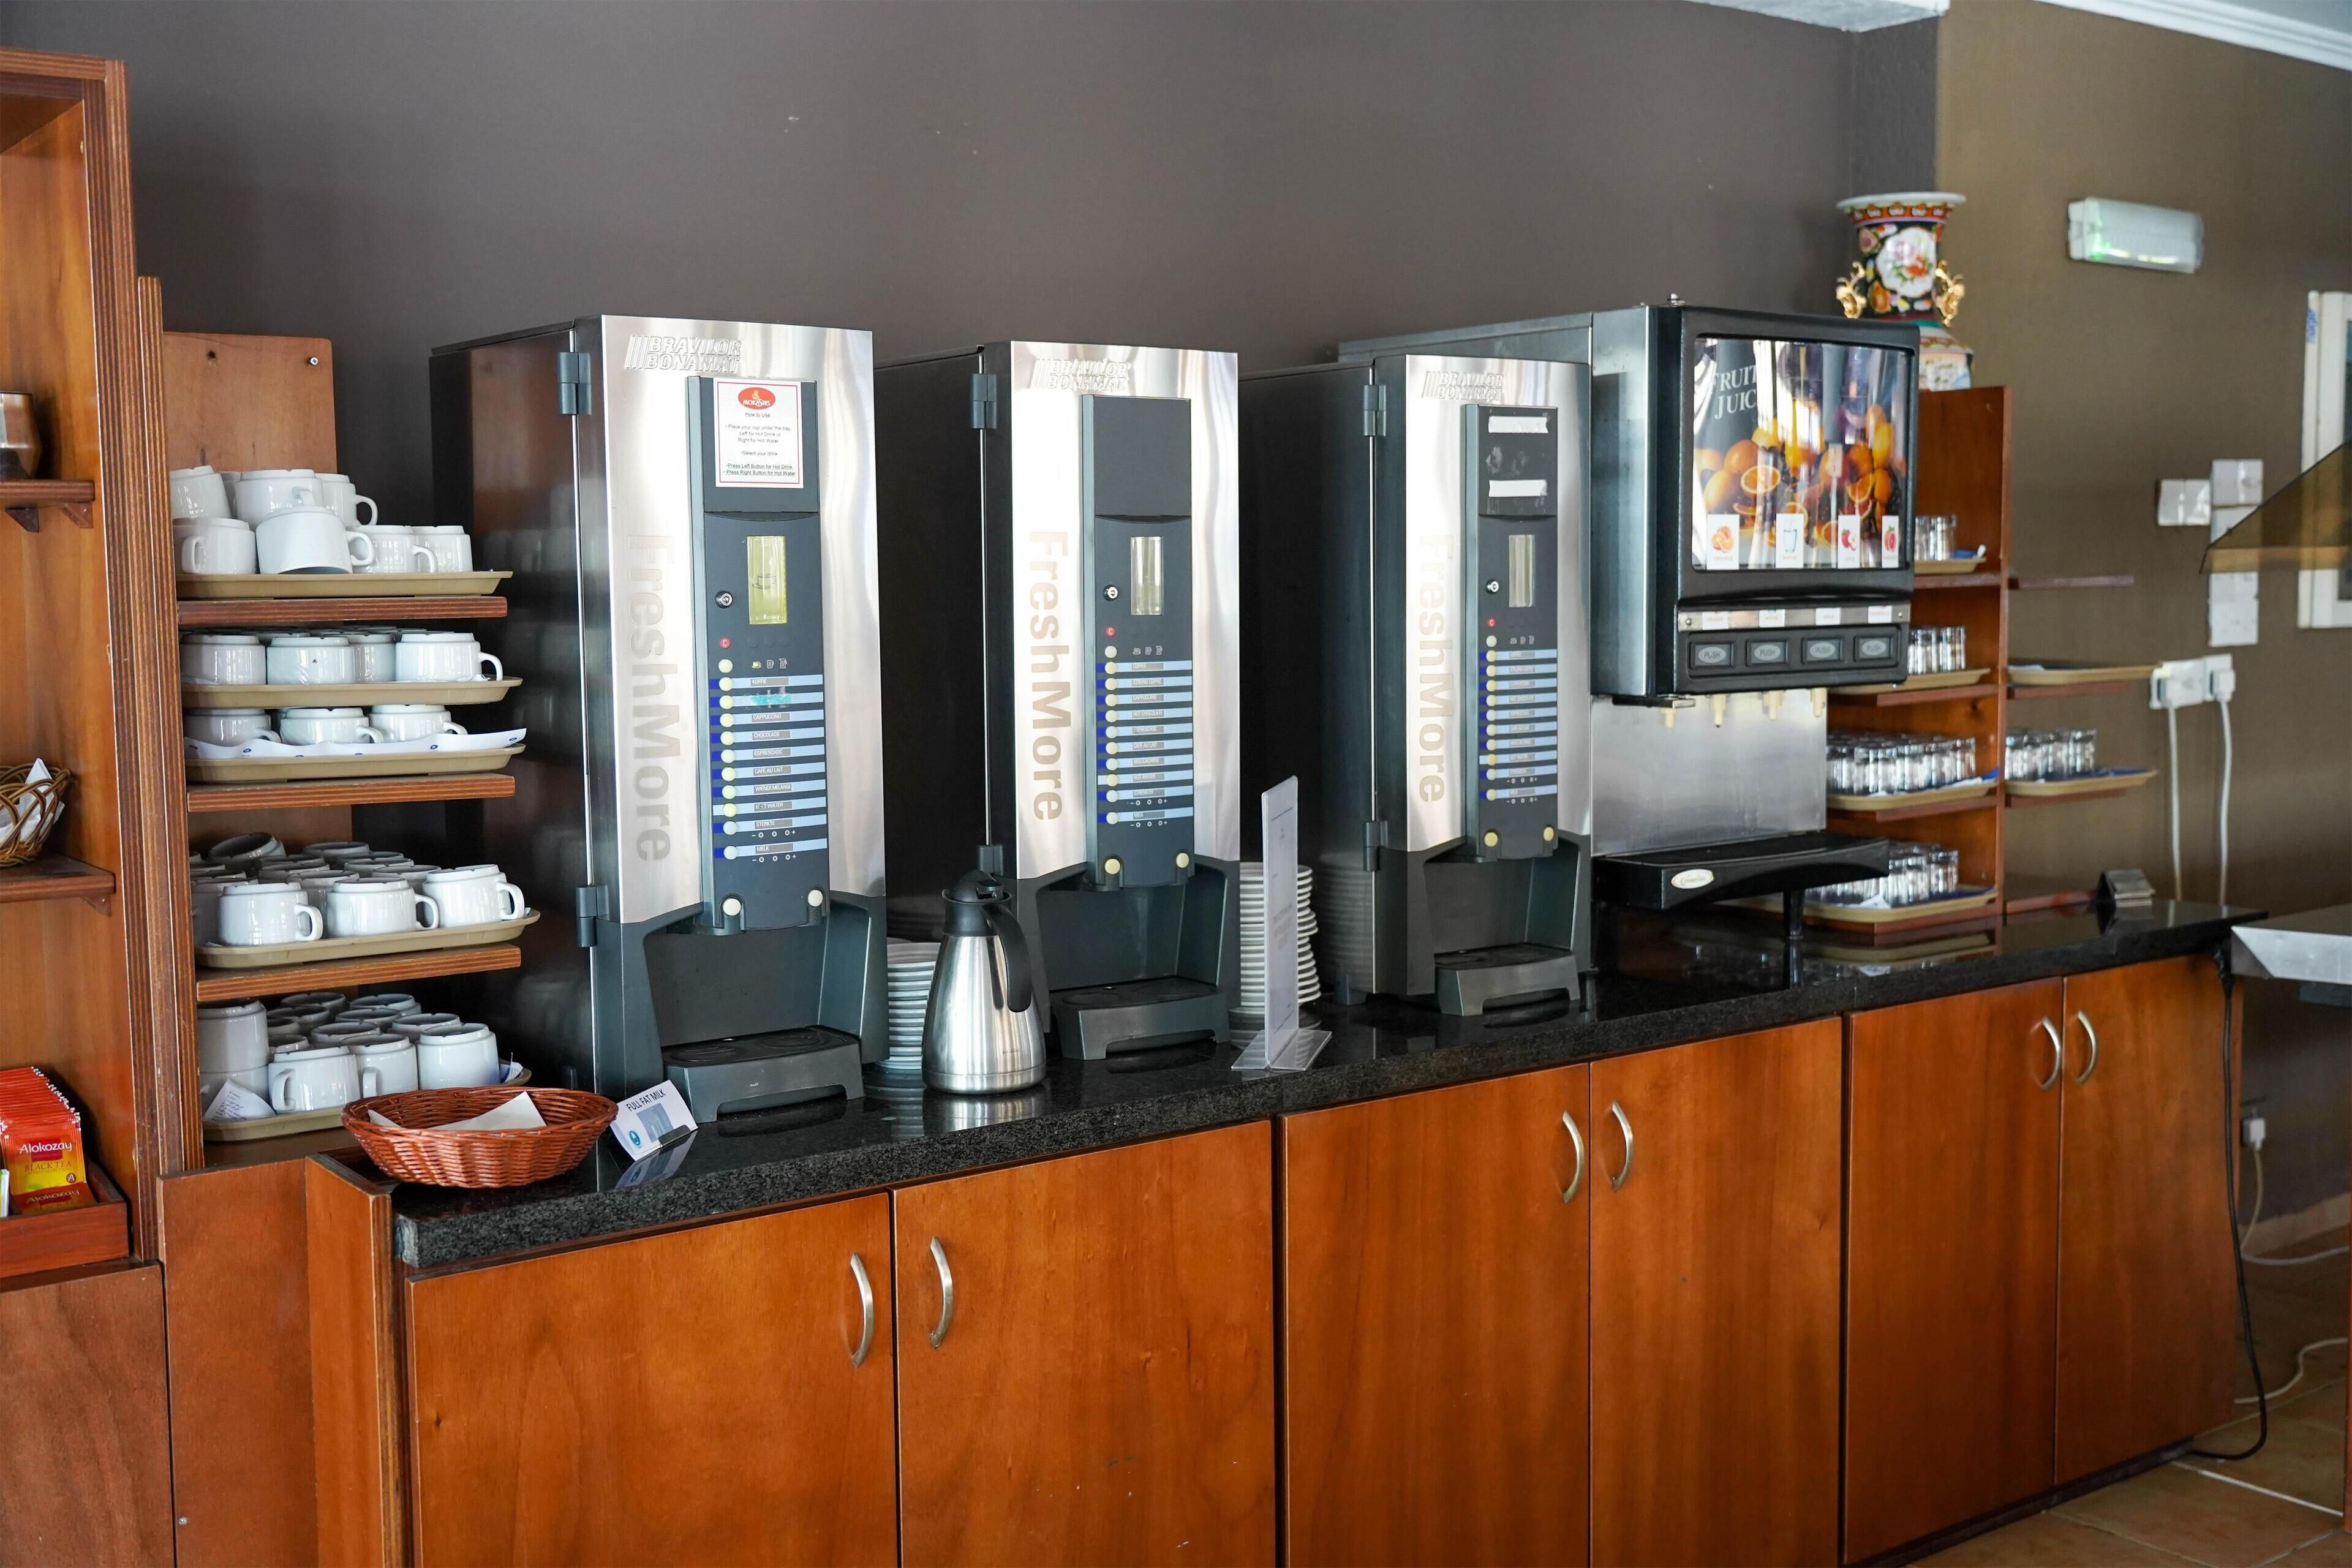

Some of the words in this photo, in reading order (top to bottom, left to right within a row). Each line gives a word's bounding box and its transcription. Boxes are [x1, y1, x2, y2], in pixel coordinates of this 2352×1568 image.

[648, 336, 741, 356] BRAVILOR
[645, 353, 740, 372] BONAMAT
[1050, 359, 1130, 377] BRAVILOR
[1048, 374, 1128, 391] BONAMAT
[1439, 372, 1504, 387] BRAVILOR
[1436, 386, 1503, 401] BONAMAT
[1714, 389, 1757, 420] JUIC
[1704, 650, 1720, 659] PUSH
[1029, 531, 1071, 821] FreshMore
[1419, 534, 1453, 802] FreshMore
[628, 535, 680, 862] FreshMore
[626, 1100, 643, 1112] FULL
[640, 1095, 652, 1106] FAT
[650, 1088, 666, 1101] MILK
[19, 1141, 72, 1155] Alokozay
[24, 1161, 53, 1172] BLACK
